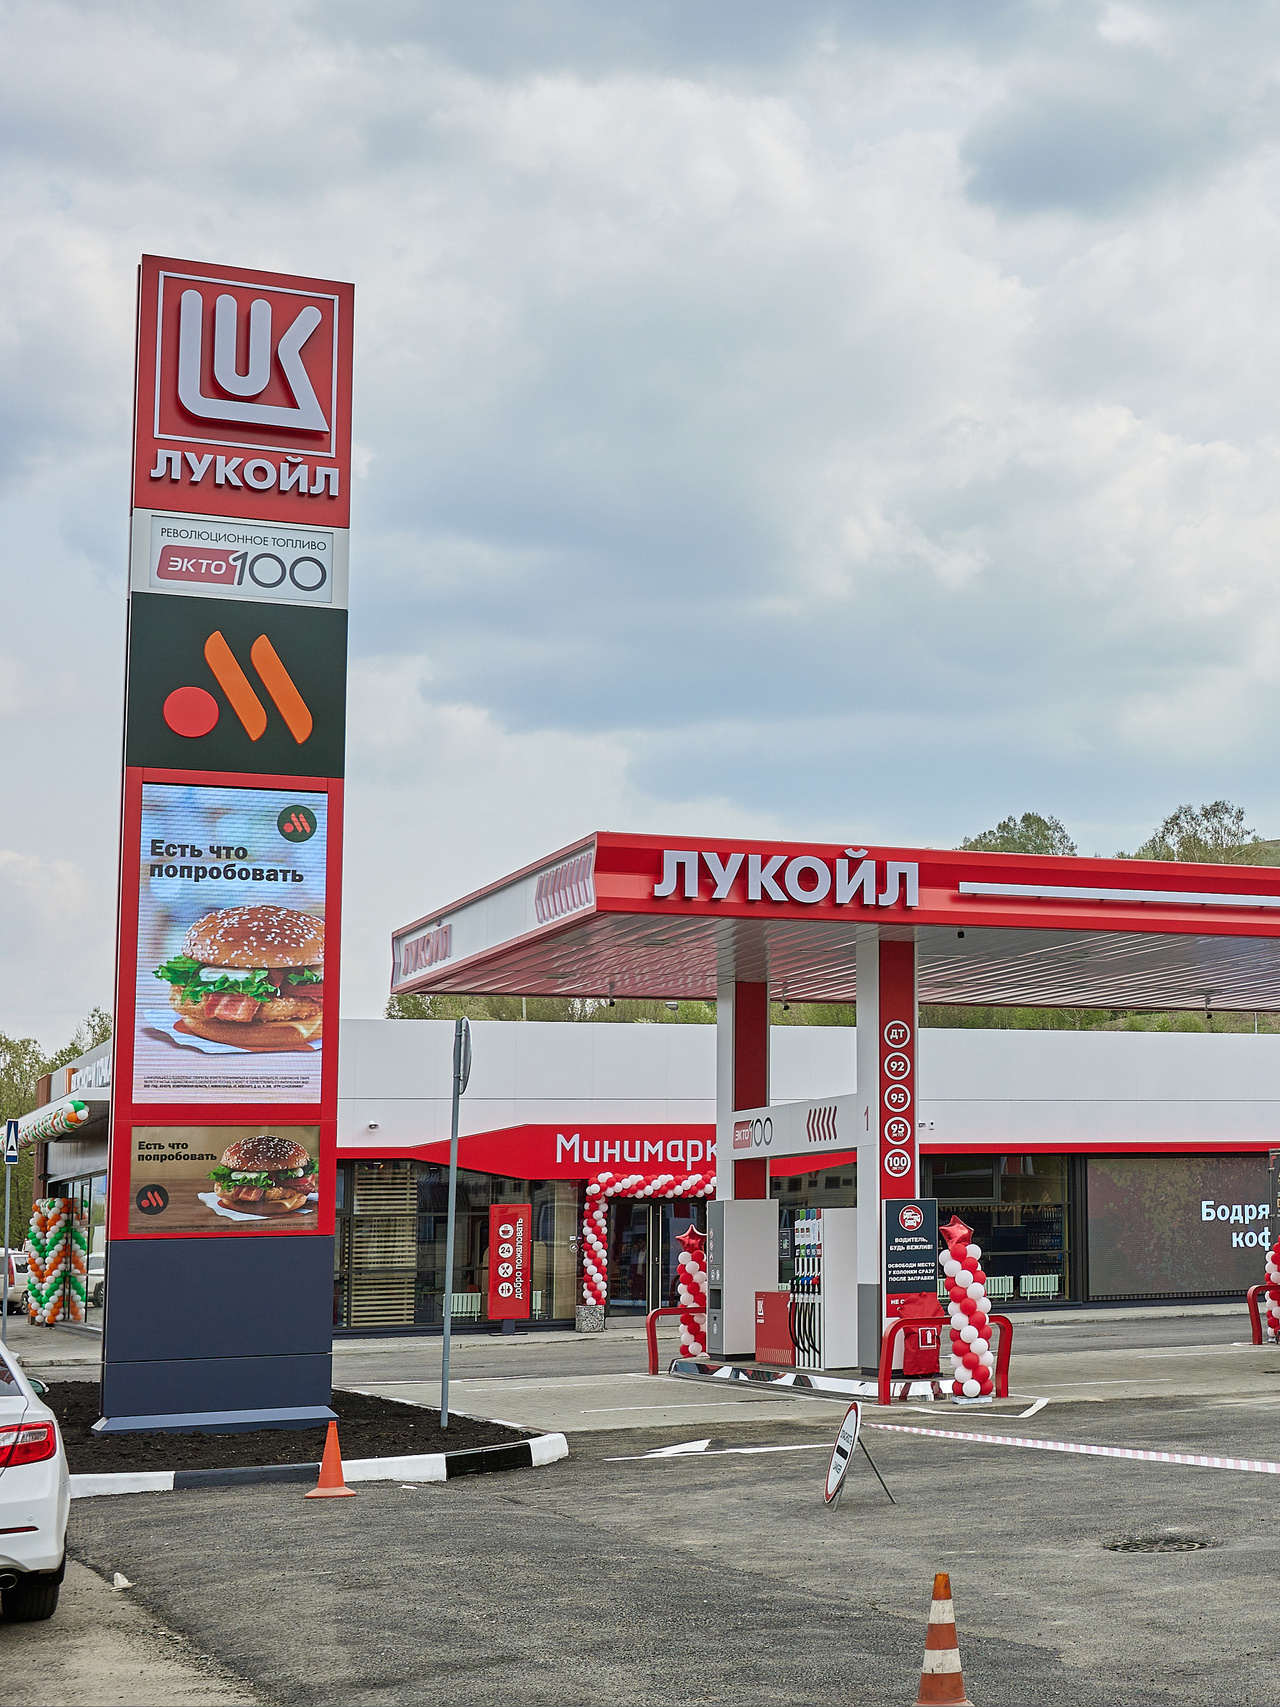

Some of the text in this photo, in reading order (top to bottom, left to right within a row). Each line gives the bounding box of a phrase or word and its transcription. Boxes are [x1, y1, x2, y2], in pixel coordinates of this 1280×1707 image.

[151, 449, 339, 497] ЛУКОЙЛ
[161, 527, 327, 551] РЕВОЛЮЦИОННОЕ ТОПЛИВО
[167, 551, 327, 591] ЭКТО 100
[150, 839, 248, 860] Есть что
[150, 864, 304, 882] попробовать
[654, 848, 919, 907] ЛУКОЙЛ
[402, 920, 451, 976] ЛУКОЙЛ
[889, 1029, 905, 1040] ДТ
[890, 1061, 905, 1071] 92
[890, 1093, 905, 1103] 95
[863, 1105, 869, 1131] 1
[890, 1123, 905, 1133] 95
[735, 1117, 773, 1147] ЭКТО 100
[137, 1151, 217, 1163] попробовать
[138, 1141, 189, 1150] Есть что
[556, 1133, 717, 1171] Минимарк
[888, 1157, 907, 1167] 100
[1201, 1200, 1270, 1224] Бодря
[1231, 1227, 1271, 1251] коф
[514, 1271, 524, 1299] добро
